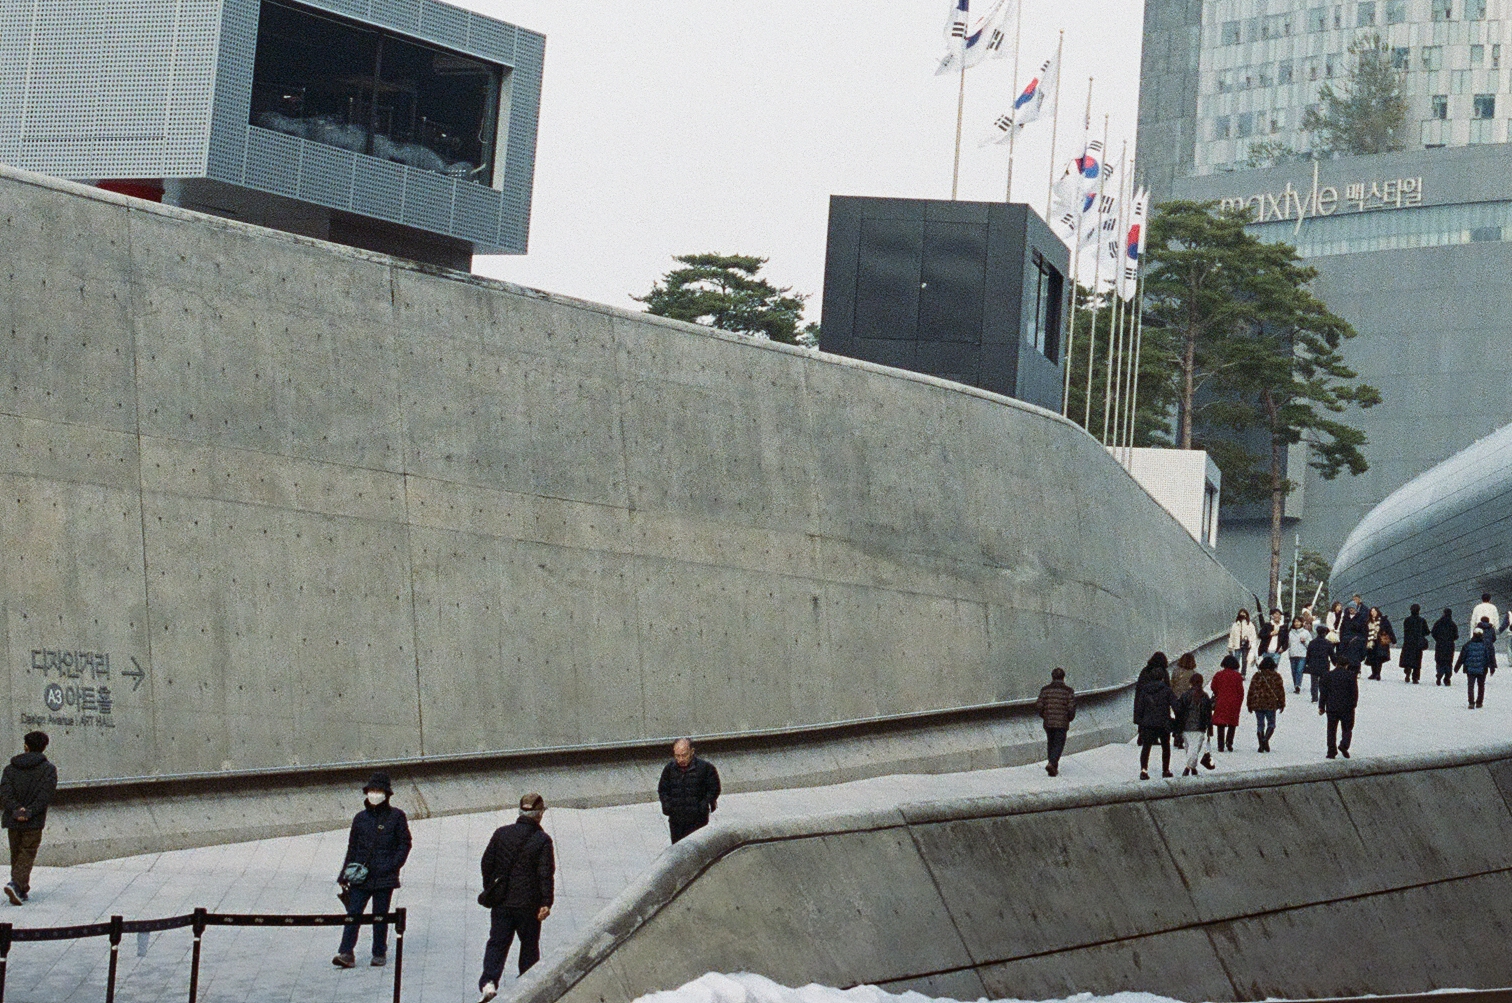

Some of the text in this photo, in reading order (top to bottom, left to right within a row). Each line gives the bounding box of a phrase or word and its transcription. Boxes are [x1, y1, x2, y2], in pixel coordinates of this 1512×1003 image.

[1220, 160, 1422, 235] maxtyle 맥스타일
[31, 648, 110, 680] 디자인거리
[47, 684, 113, 714] A3 아트홀
